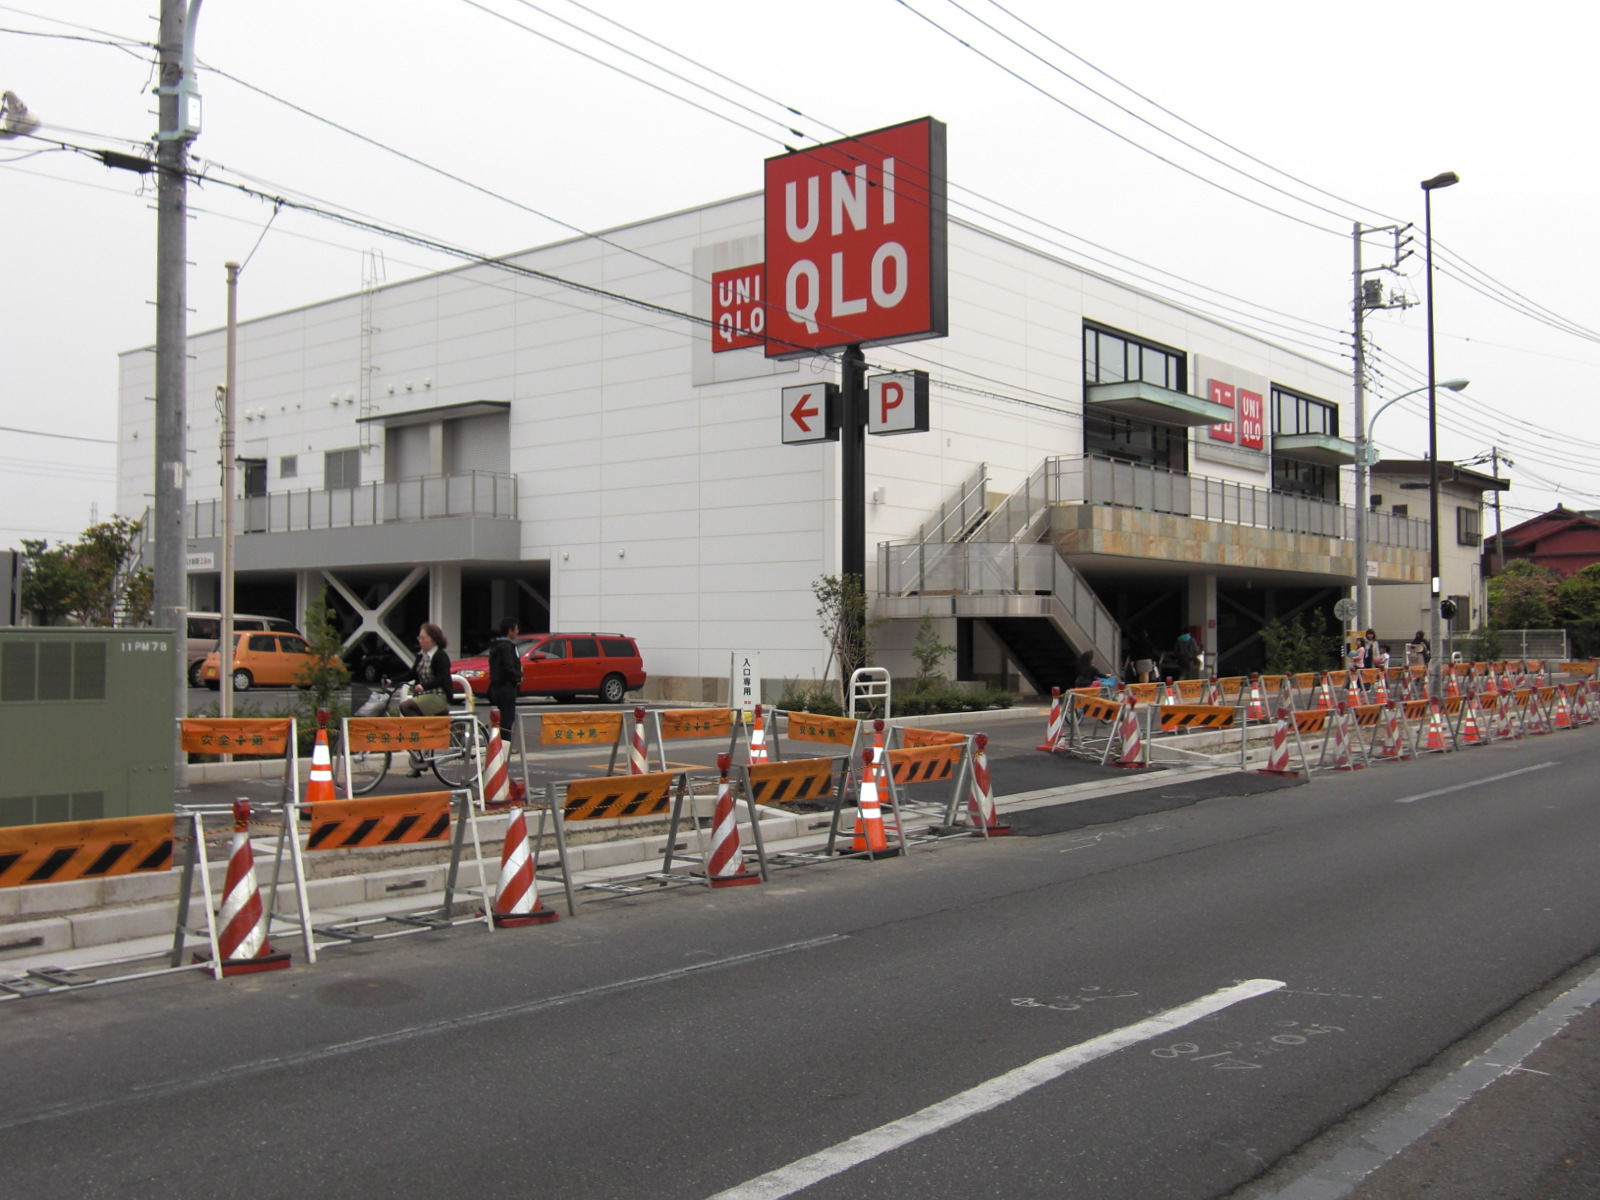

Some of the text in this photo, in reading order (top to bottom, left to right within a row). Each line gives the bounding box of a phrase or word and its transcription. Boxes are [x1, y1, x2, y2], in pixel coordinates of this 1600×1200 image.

[786, 157, 895, 243] UNI
[719, 274, 760, 308] UNI
[786, 242, 908, 334] QLO
[719, 306, 765, 343] QLO
[881, 381, 904, 424] P
[1242, 396, 1259, 419] UNI
[1243, 419, 1261, 442] QLO
[743, 658, 751, 696] 入口専用
